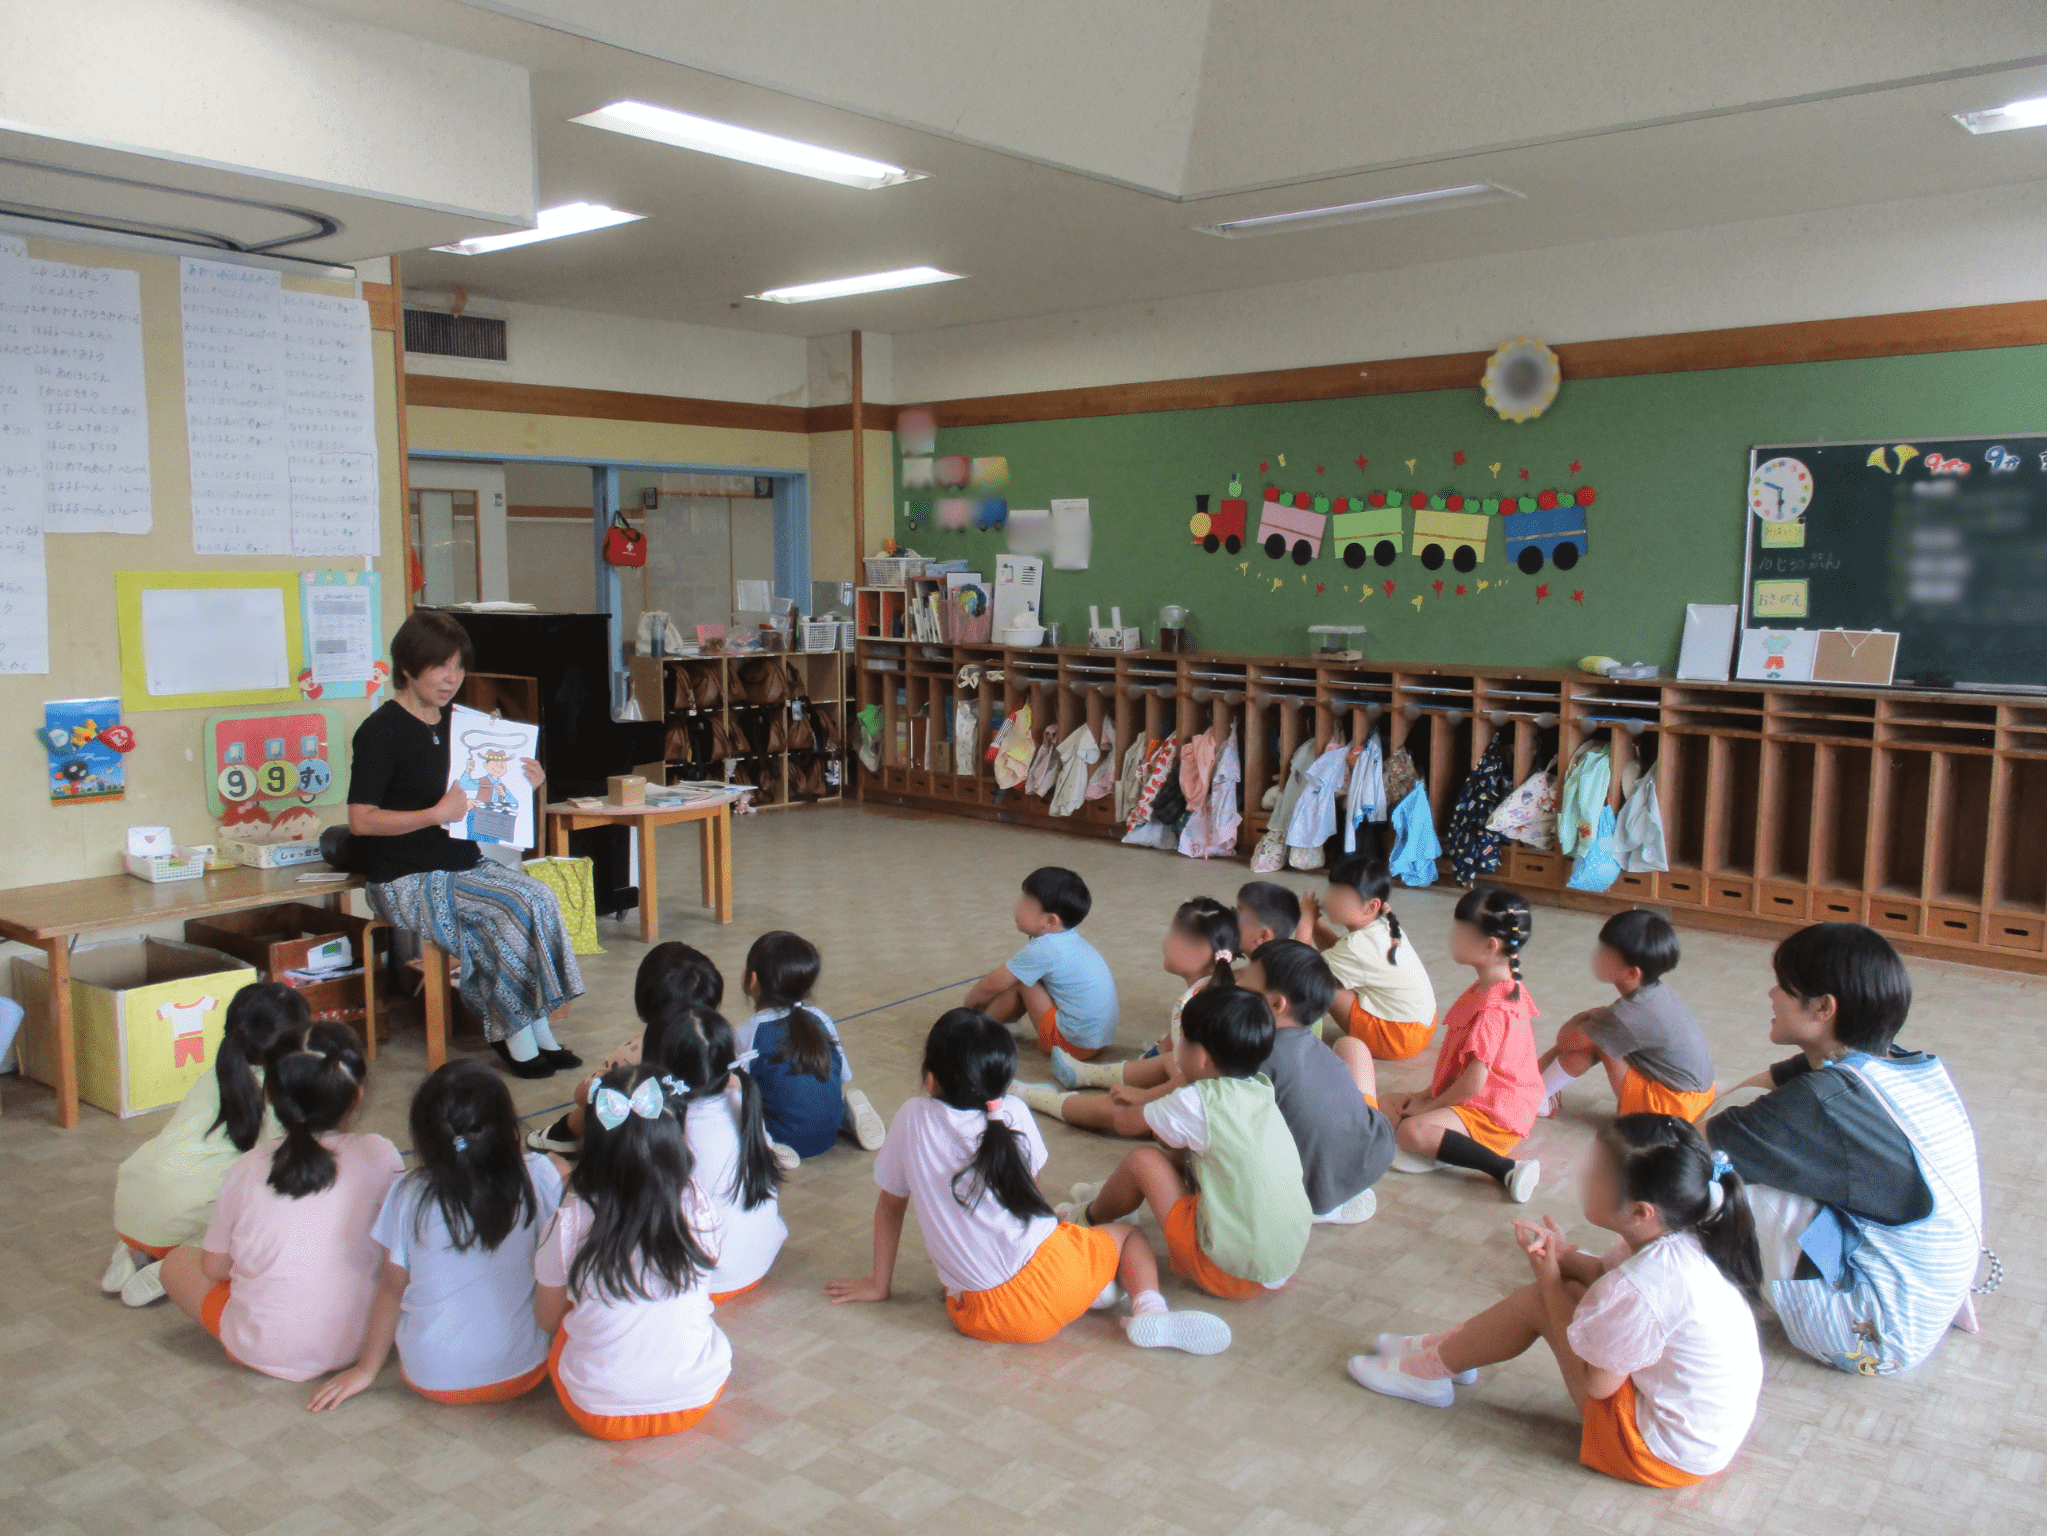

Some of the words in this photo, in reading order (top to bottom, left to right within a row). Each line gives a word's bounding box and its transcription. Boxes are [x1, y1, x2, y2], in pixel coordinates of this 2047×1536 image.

[1758, 592, 1803, 607] おきがえ
[227, 769, 248, 798] 9
[267, 766, 286, 792] 9
[299, 766, 330, 790] すい
